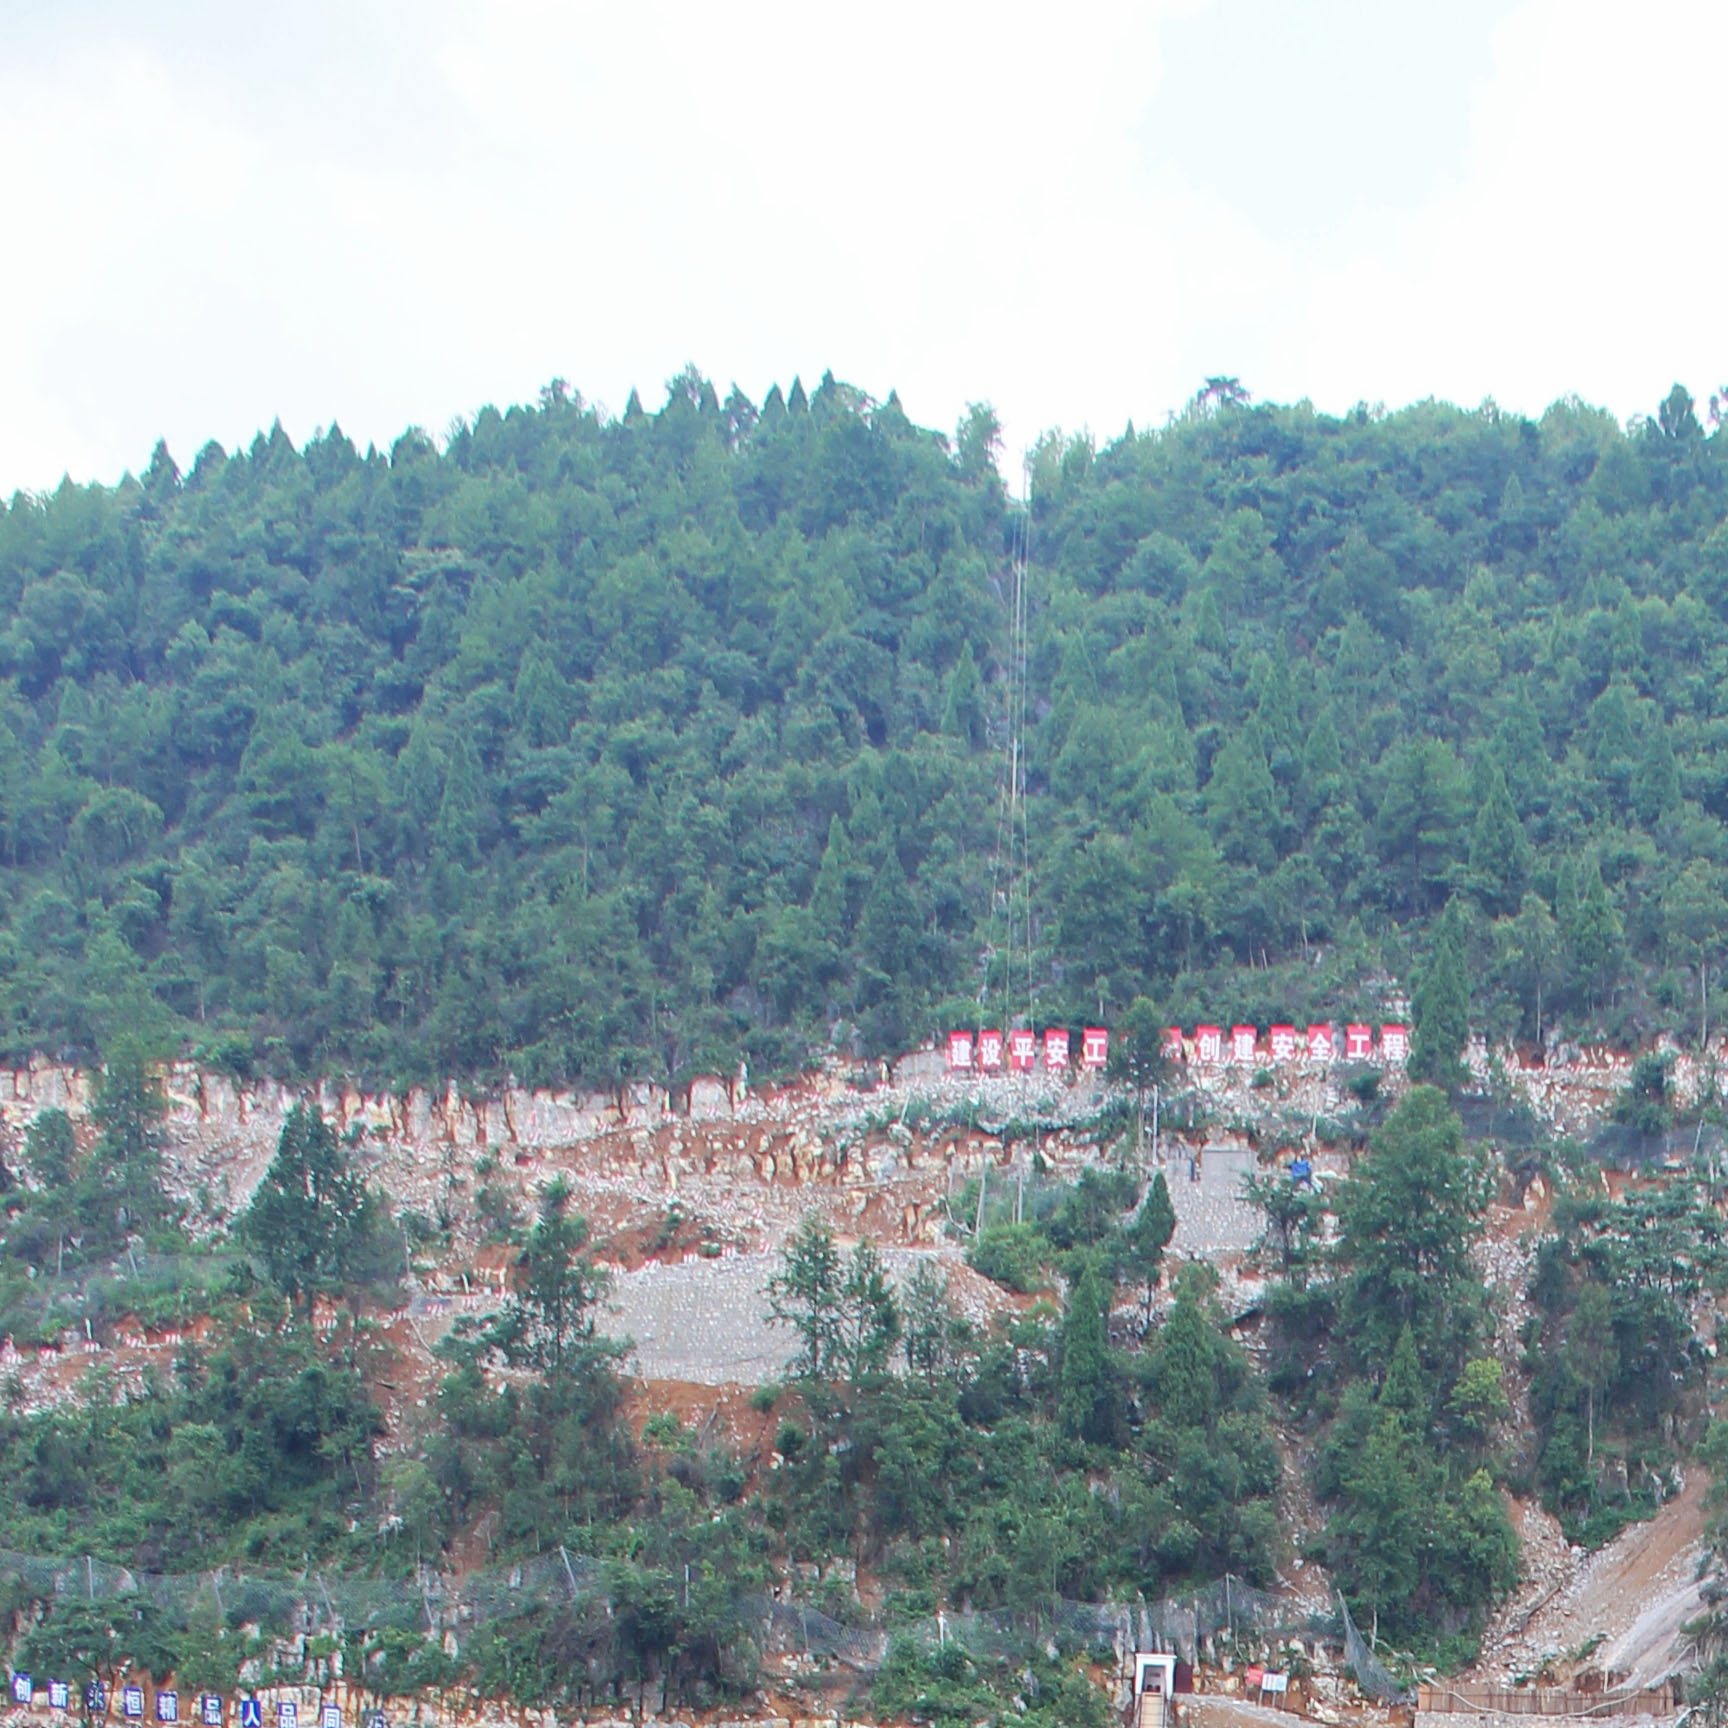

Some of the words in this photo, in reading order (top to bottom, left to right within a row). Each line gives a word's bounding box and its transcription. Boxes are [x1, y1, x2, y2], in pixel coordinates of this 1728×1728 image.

[1200, 1032, 1405, 1061] 创建安全工程
